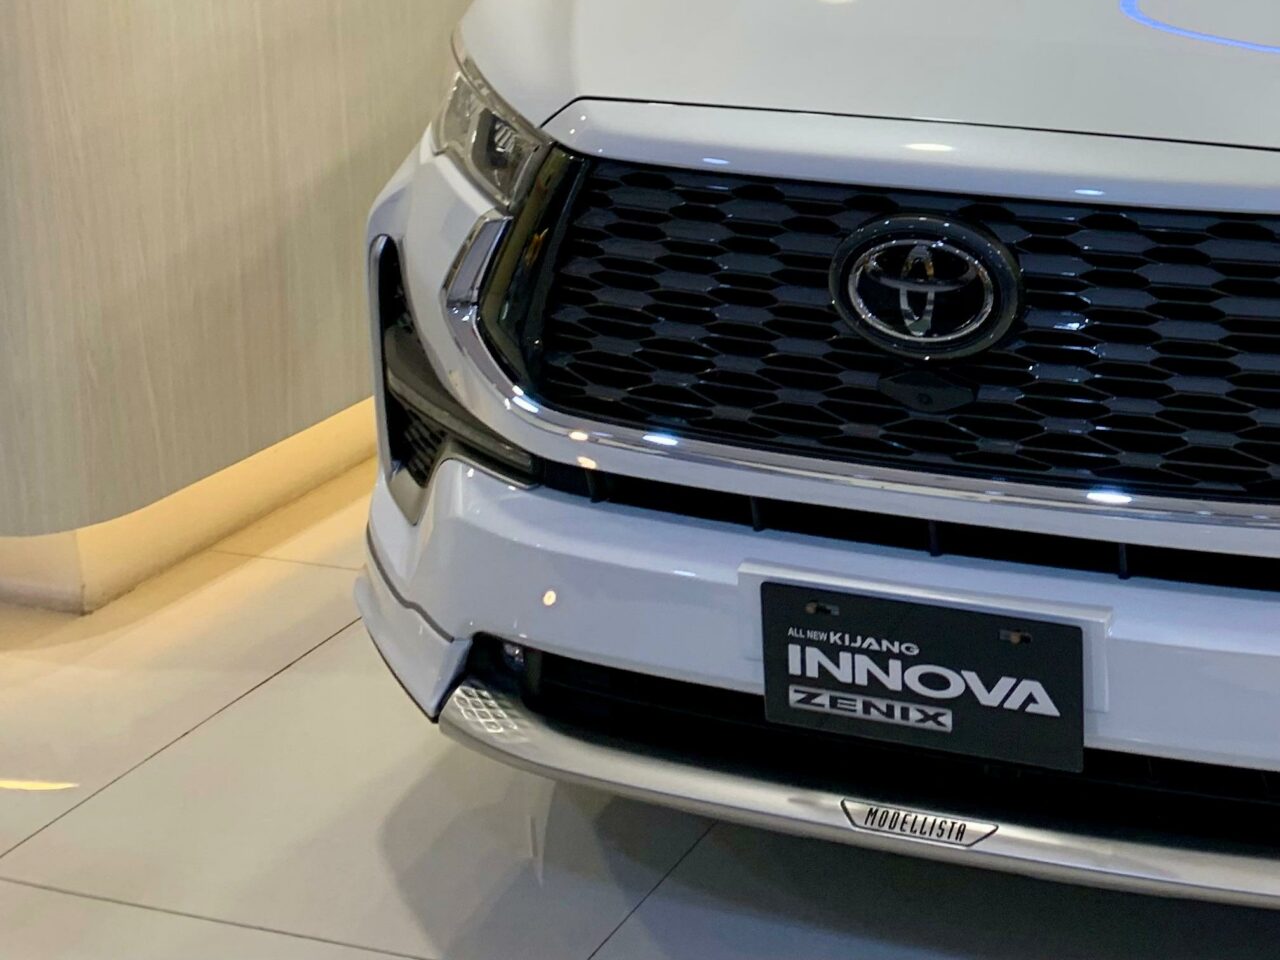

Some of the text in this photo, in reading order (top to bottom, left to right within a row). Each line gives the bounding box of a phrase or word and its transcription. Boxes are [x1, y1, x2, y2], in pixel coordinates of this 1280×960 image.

[787, 627, 920, 656] ALL NEW KIJANG
[787, 643, 1061, 717] INNOVA
[792, 690, 949, 729] ZENIX
[863, 807, 968, 842] MODELLISTA
